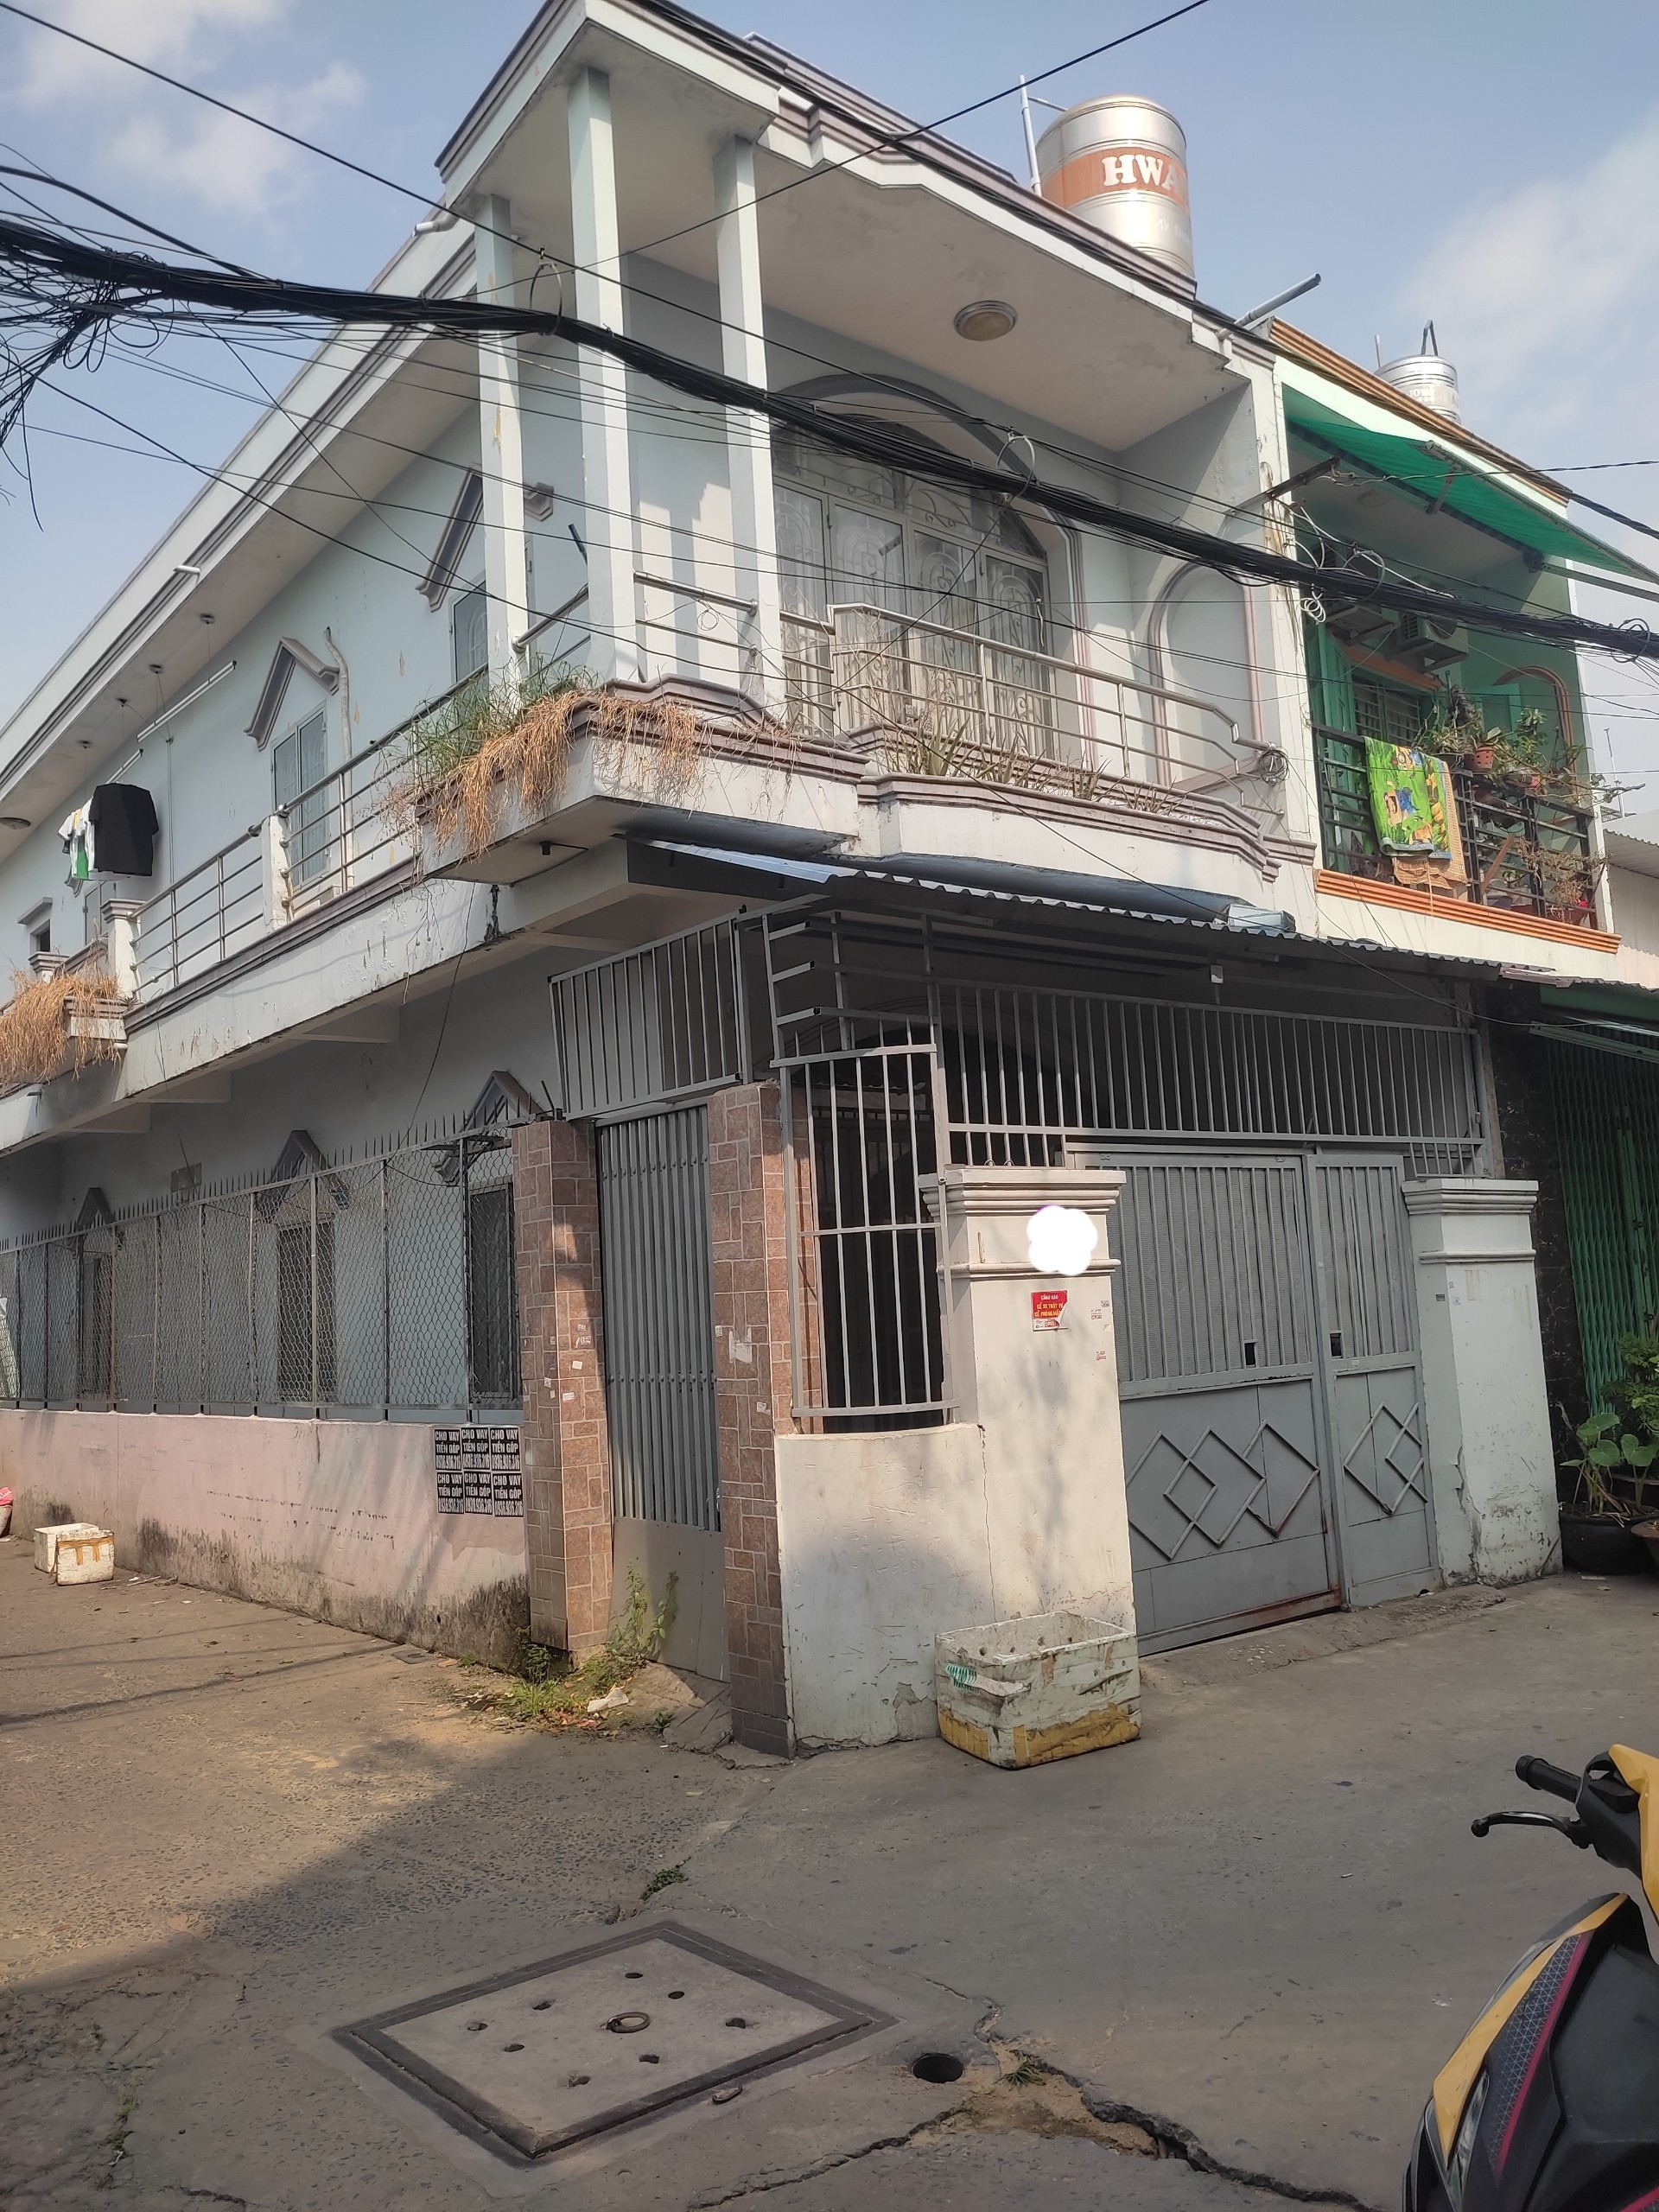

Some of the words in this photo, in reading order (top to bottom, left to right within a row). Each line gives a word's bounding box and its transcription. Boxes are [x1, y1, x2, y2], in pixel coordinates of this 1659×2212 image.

[435, 1431, 447, 1441] CHO
[448, 1431, 460, 1441] VAY
[461, 1429, 474, 1440] CHO
[476, 1429, 487, 1440] VAY
[491, 1429, 505, 1440] CHO
[506, 1429, 518, 1440] VAY
[506, 1441, 518, 1453] GÓP
[438, 1474, 449, 1484] CHO
[451, 1474, 461, 1484] VAY
[465, 1472, 477, 1483] CHO
[479, 1473, 491, 1484] VAY
[493, 1476, 507, 1485] CHO
[509, 1476, 521, 1485] VAY
[451, 1485, 462, 1497] GÓP
[480, 1484, 491, 1497] GÓP
[509, 1487, 522, 1498] GÓP
